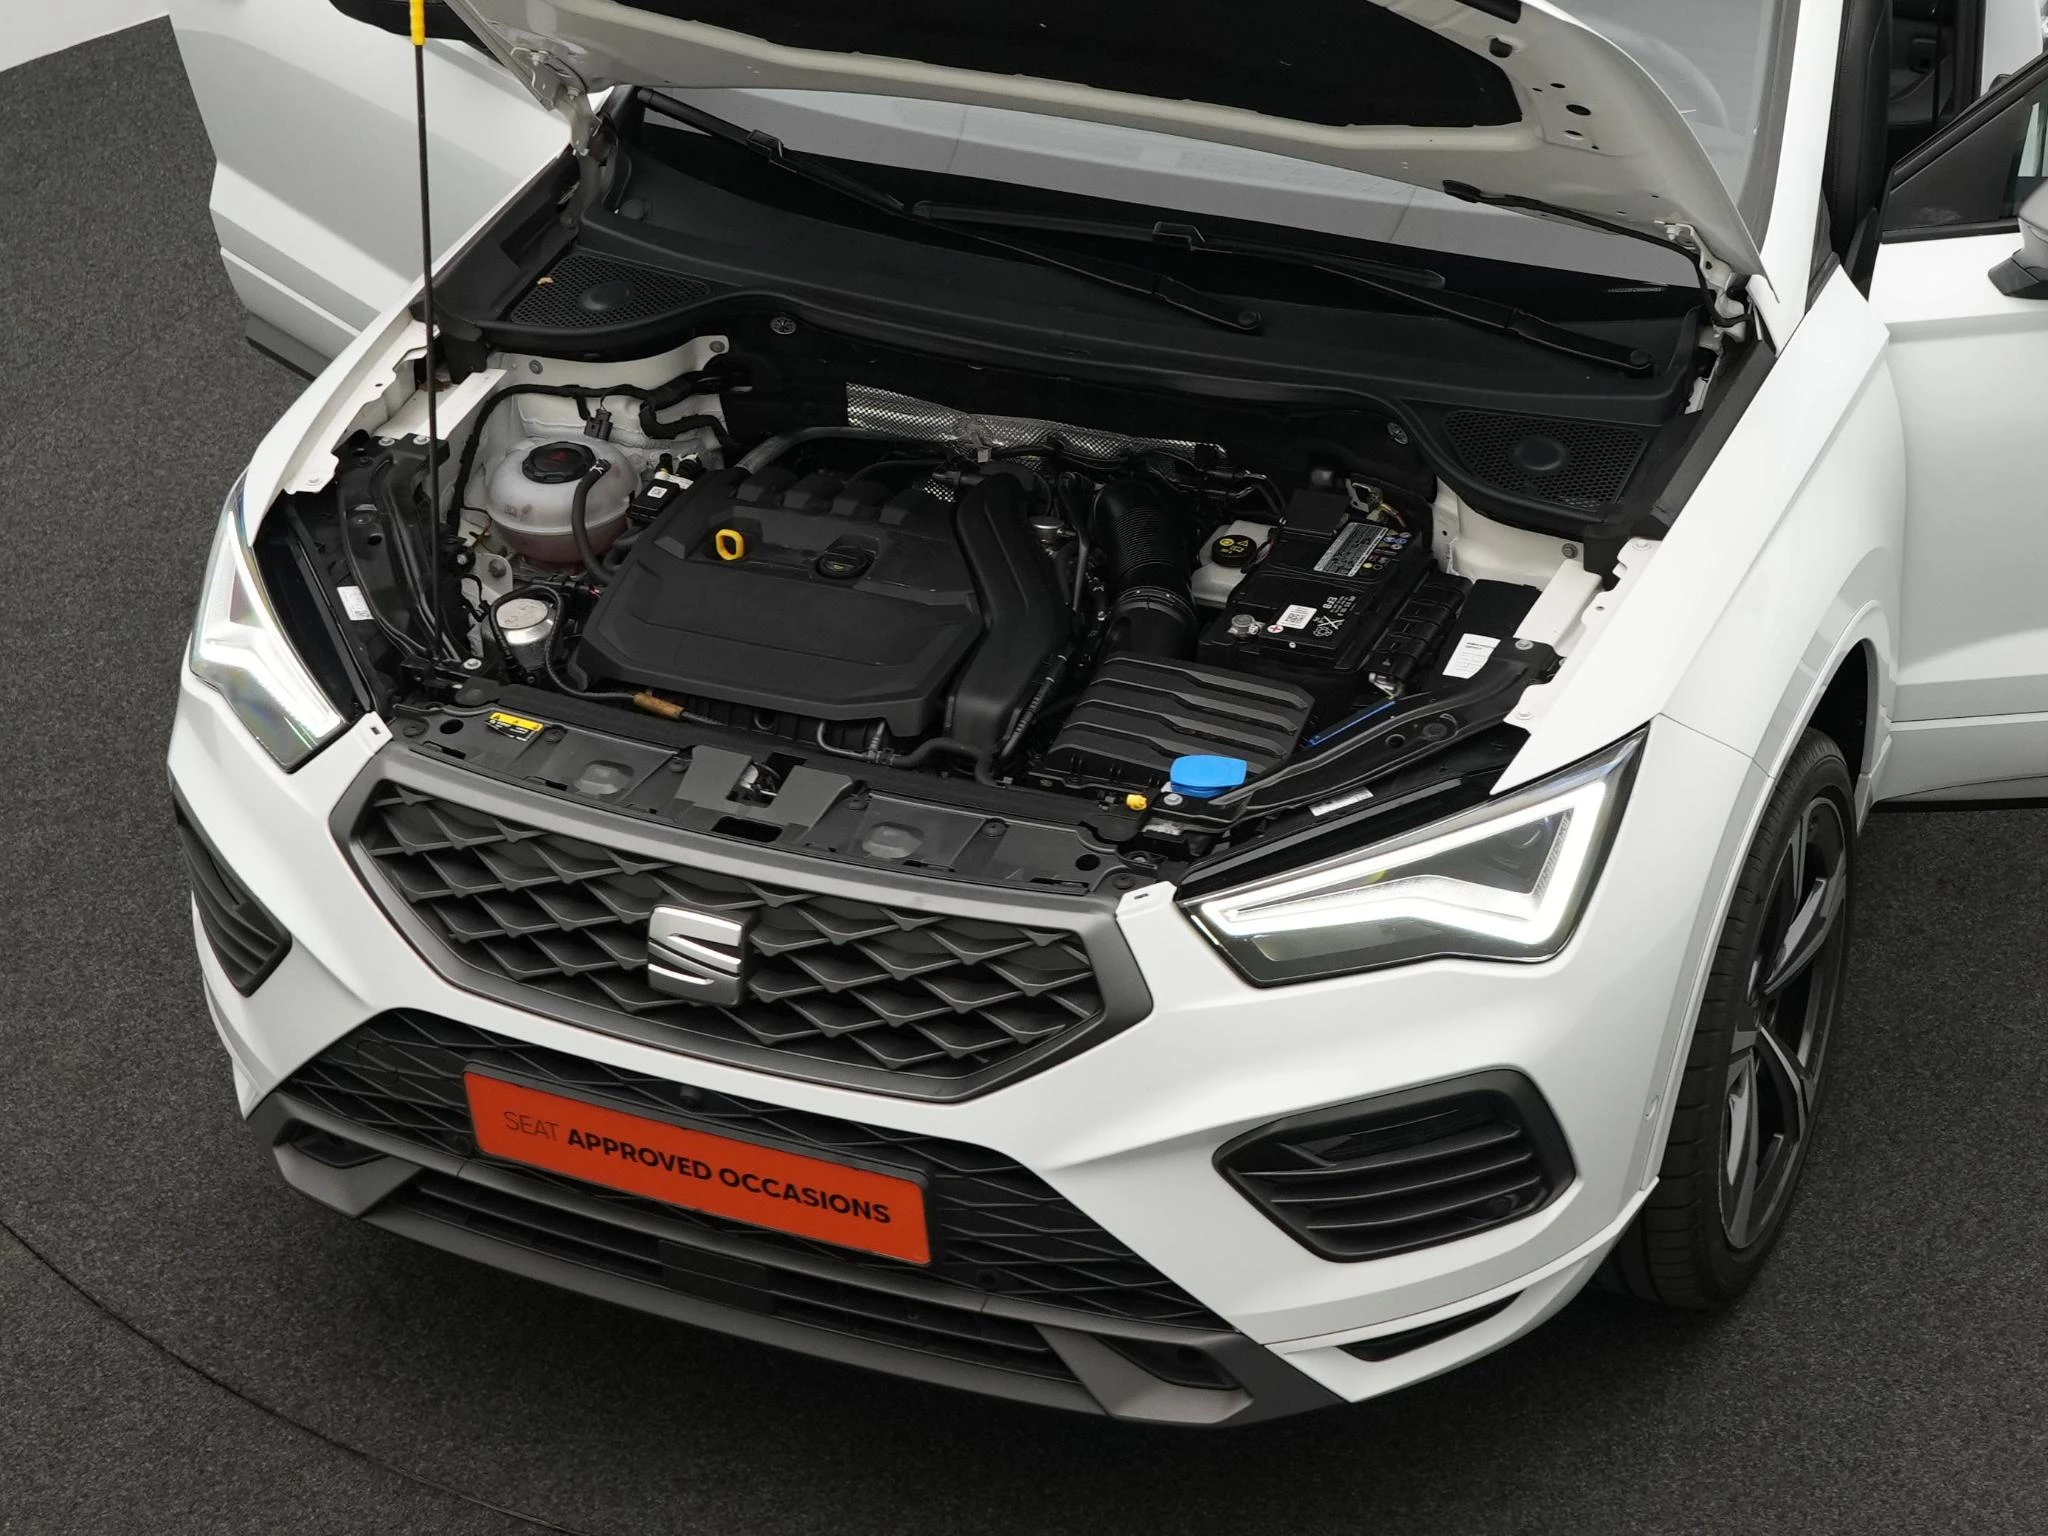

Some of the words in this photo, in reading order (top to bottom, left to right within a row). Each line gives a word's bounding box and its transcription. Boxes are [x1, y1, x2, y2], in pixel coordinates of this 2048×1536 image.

[503, 1110, 560, 1141] SEAT
[567, 1128, 712, 1180] APPROVED
[718, 1168, 891, 1224] OCCASIONS
